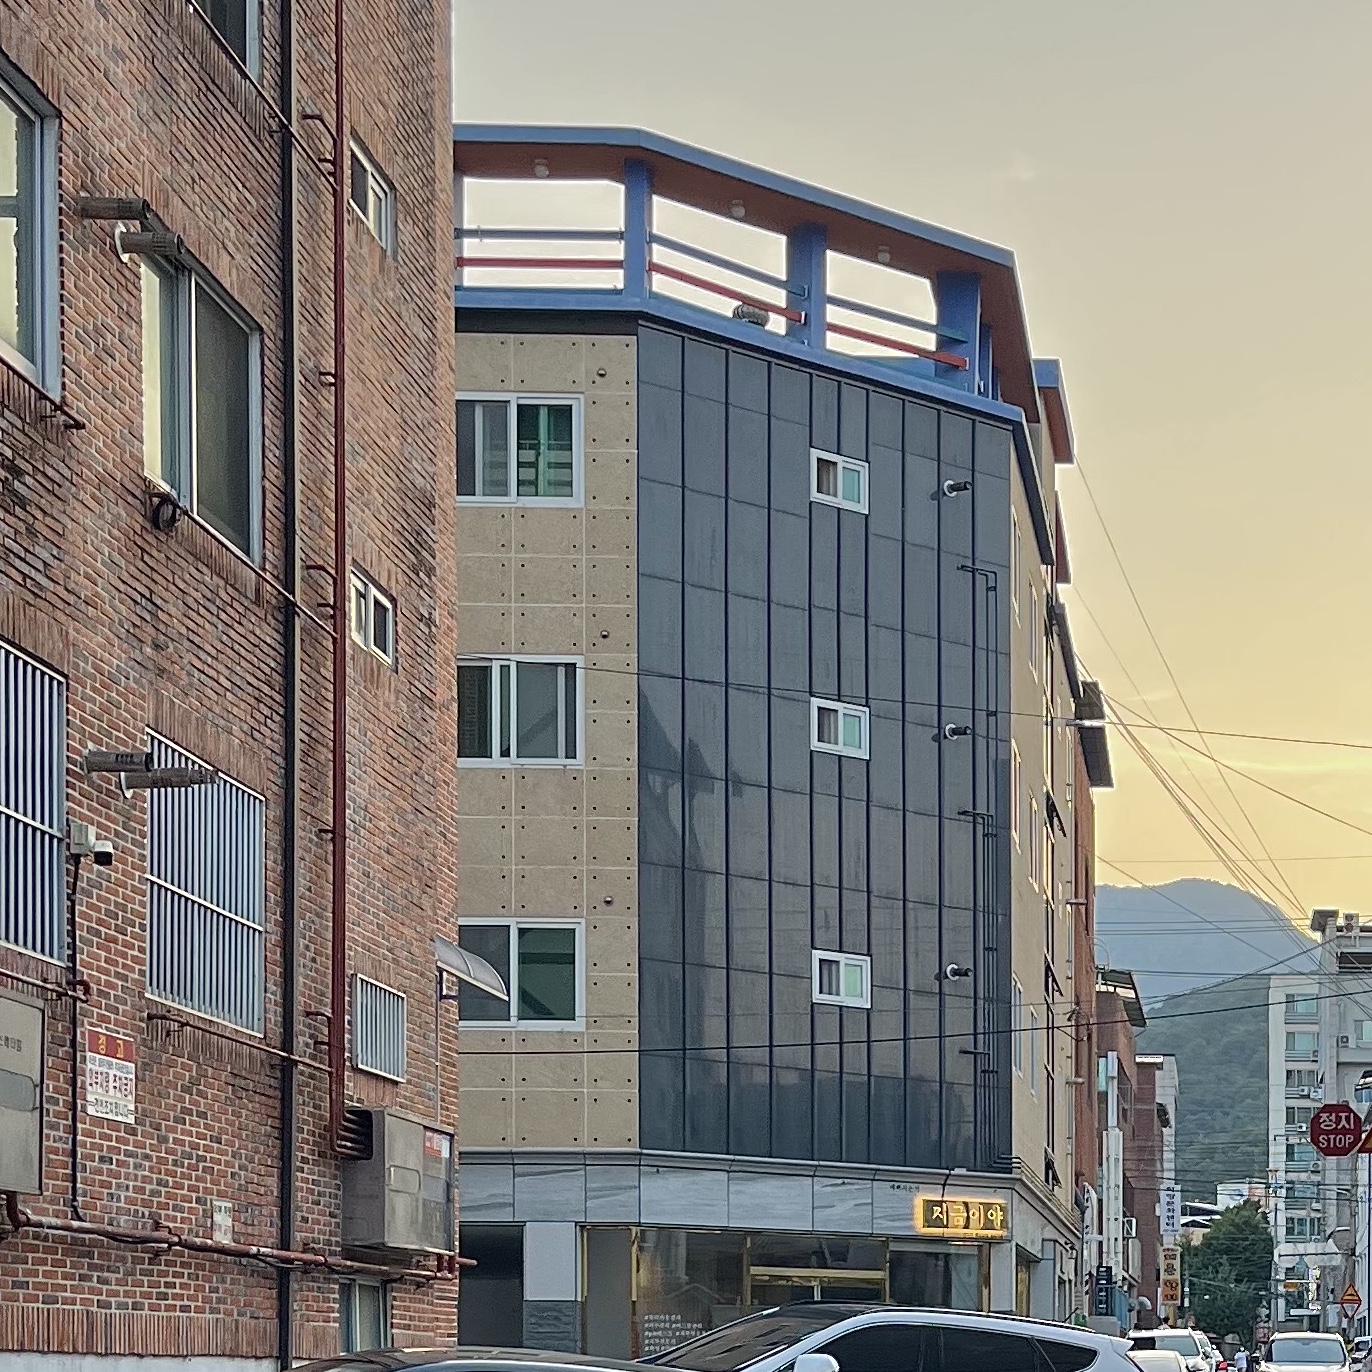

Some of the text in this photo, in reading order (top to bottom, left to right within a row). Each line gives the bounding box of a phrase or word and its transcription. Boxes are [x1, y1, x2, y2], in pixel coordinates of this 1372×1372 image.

[112, 1072, 134, 1099] 주차금지
[1319, 1112, 1354, 1130] 정지
[1319, 1134, 1354, 1148] STOP
[932, 1201, 1004, 1230] 지금이야
